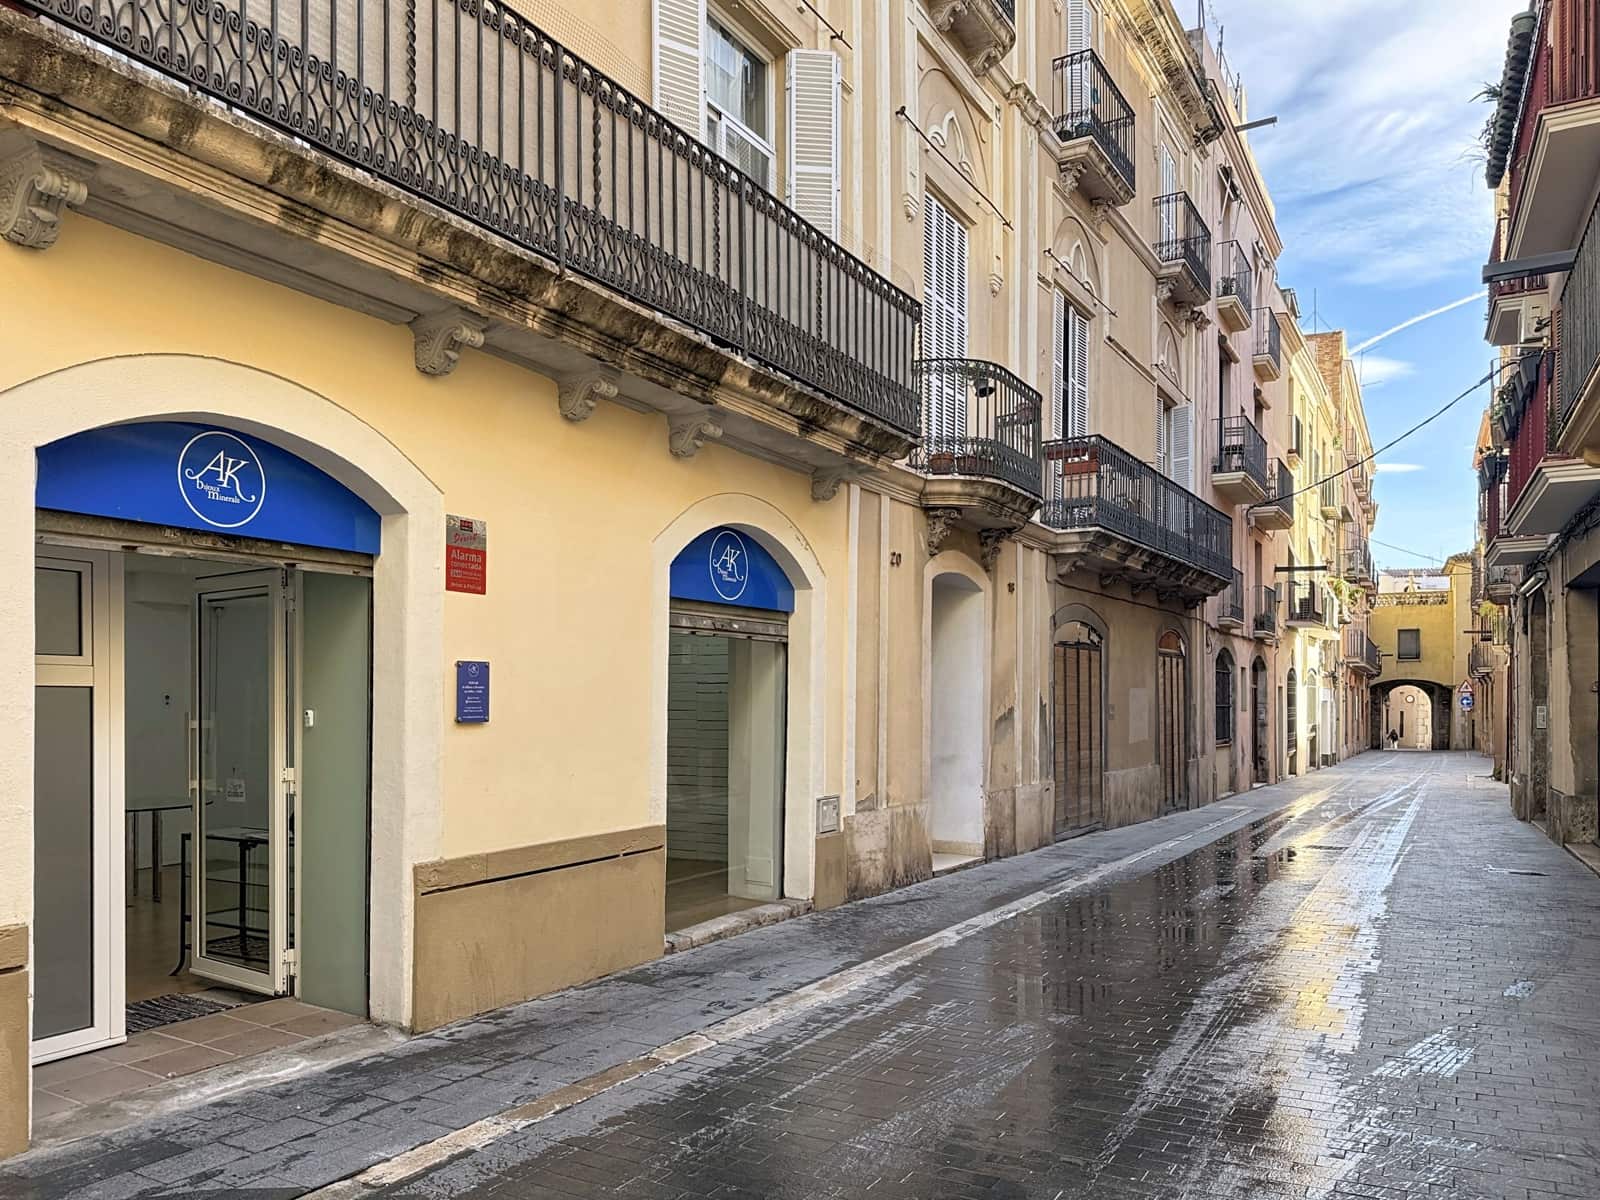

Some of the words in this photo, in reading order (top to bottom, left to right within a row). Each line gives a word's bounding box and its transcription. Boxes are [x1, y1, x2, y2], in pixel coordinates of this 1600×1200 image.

[185, 450, 255, 502] AK
[451, 549, 481, 563] Alarma
[712, 544, 744, 582] AK
[890, 551, 902, 568] 20
